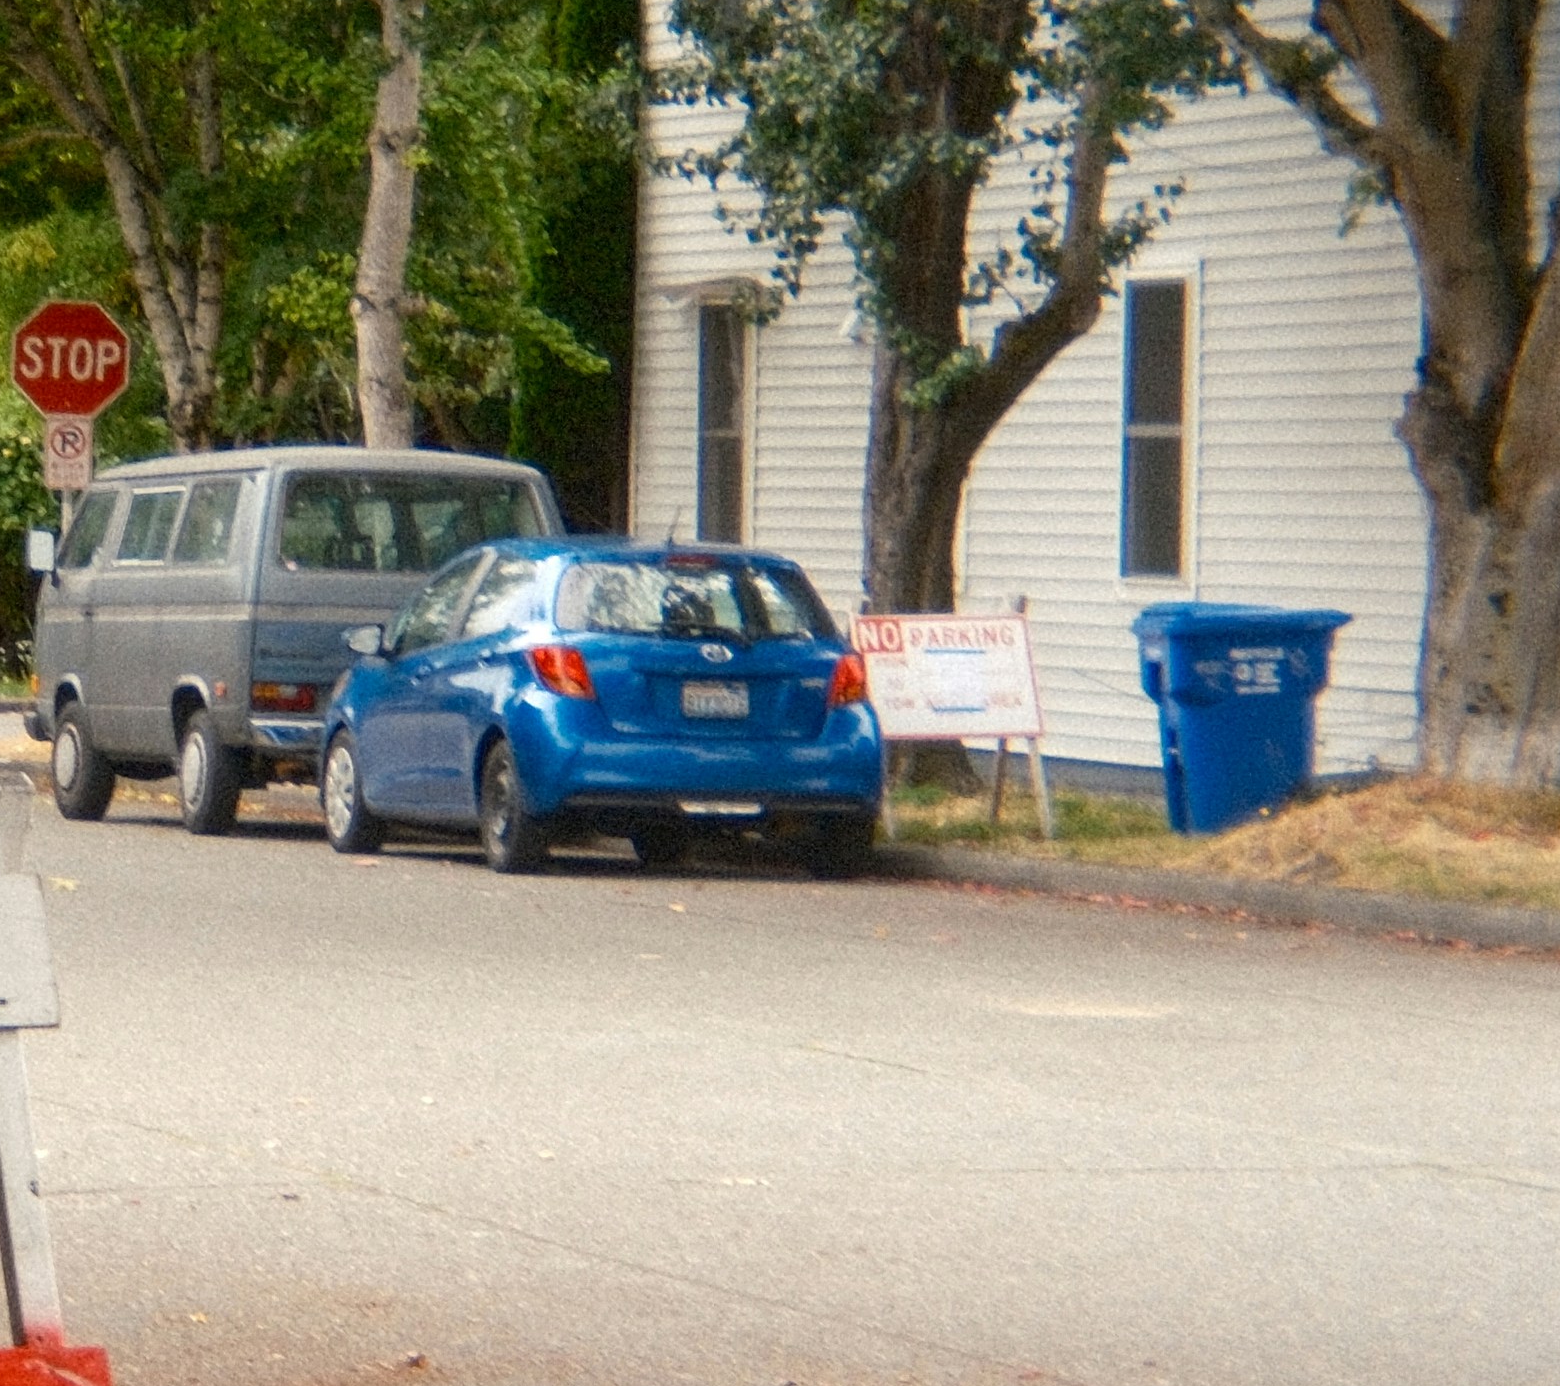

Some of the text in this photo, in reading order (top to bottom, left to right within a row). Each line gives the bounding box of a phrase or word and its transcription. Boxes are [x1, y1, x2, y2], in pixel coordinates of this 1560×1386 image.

[19, 335, 122, 383] STOP
[858, 620, 1016, 652] NO PARKING
